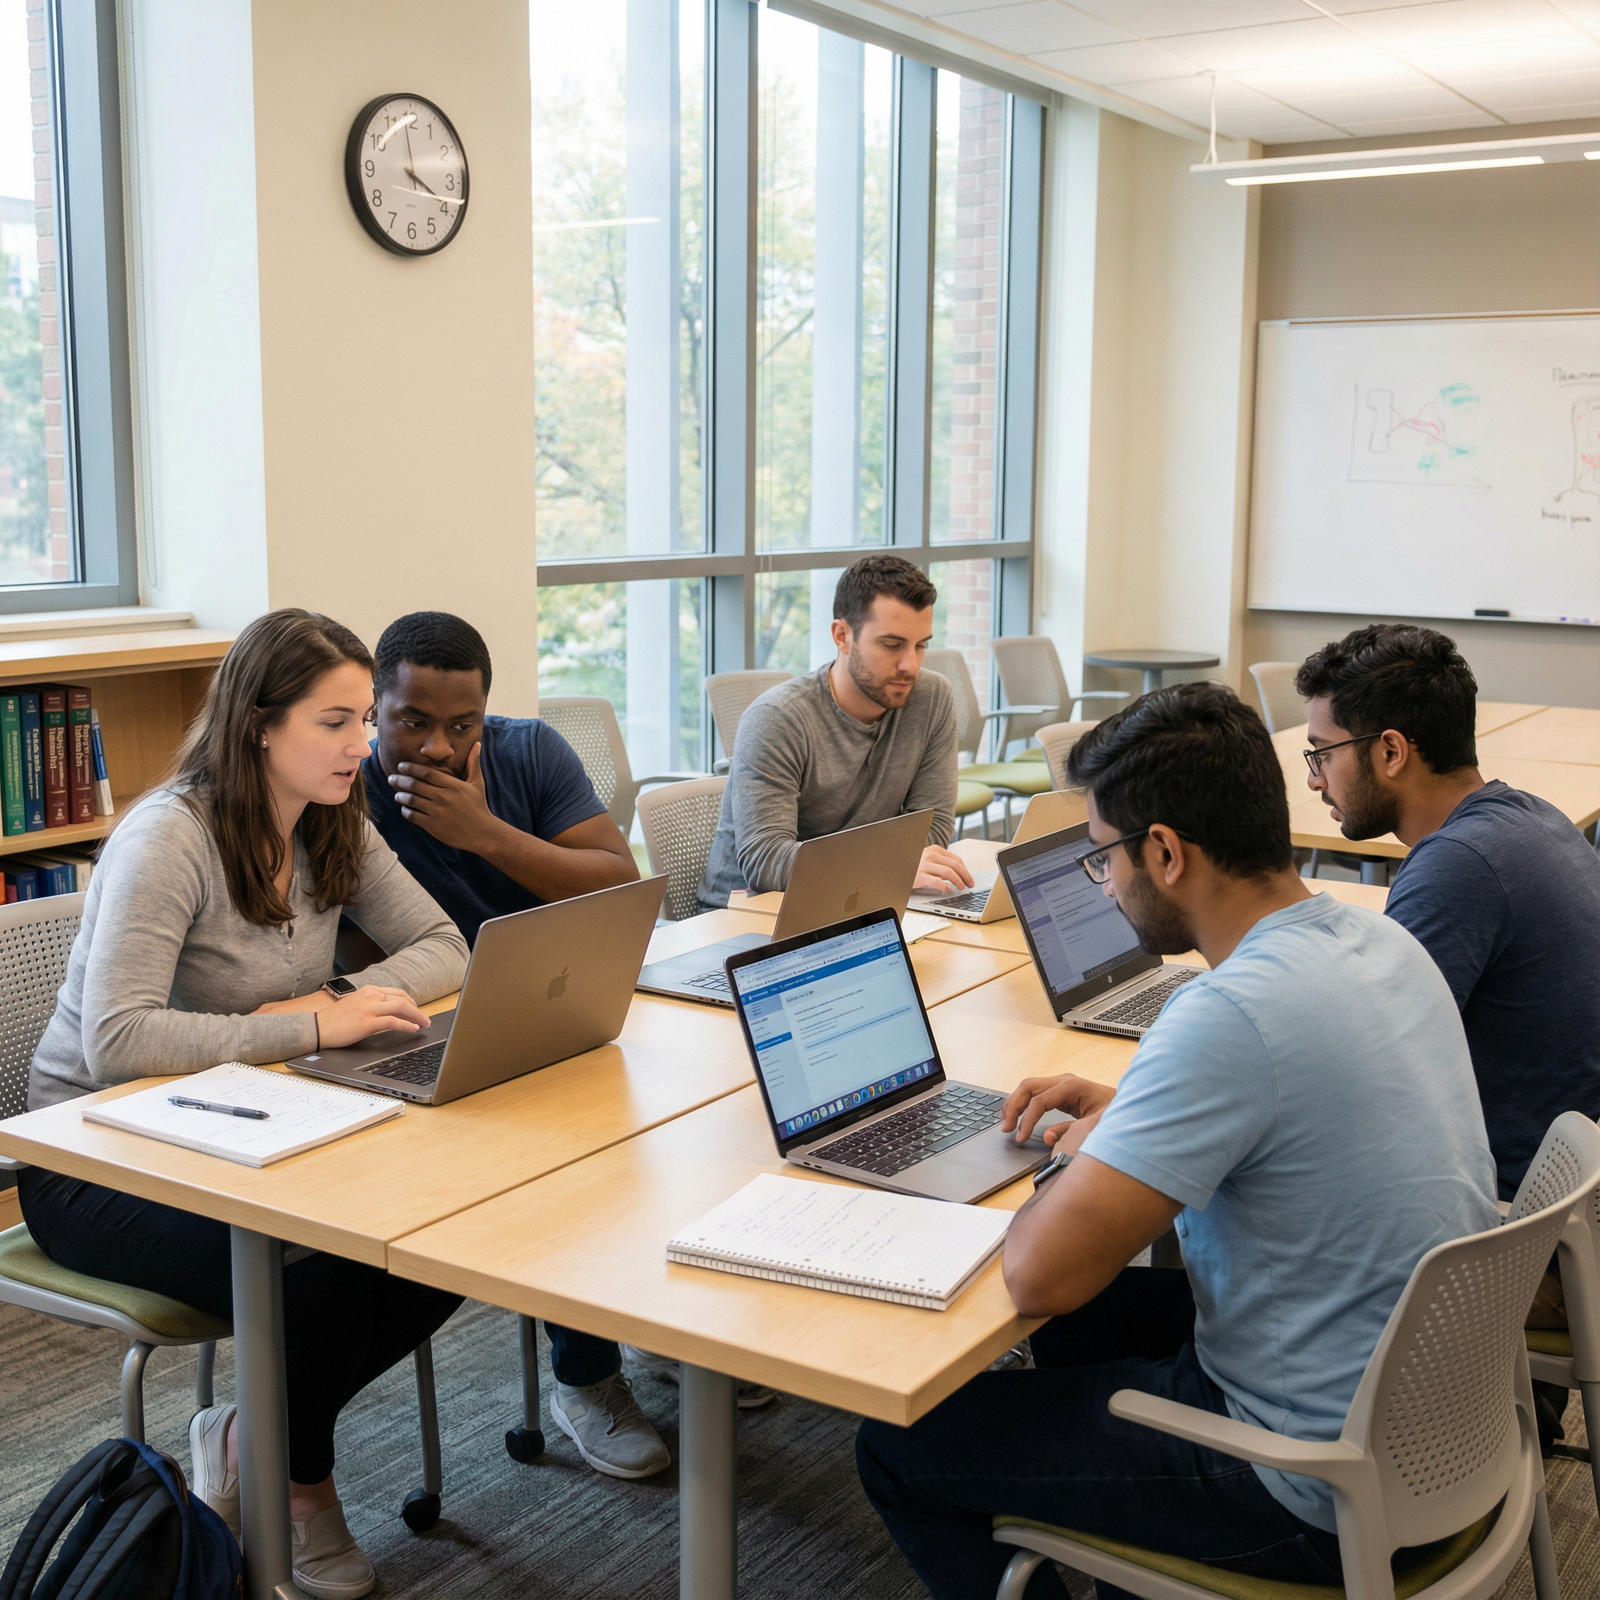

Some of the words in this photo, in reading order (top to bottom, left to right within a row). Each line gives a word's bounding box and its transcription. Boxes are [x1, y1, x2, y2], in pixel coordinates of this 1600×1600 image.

[384, 114, 398, 135] 11
[402, 110, 419, 130] 12
[426, 122, 433, 140] 1
[370, 133, 387, 152] 10
[439, 144, 449, 162] 2
[364, 159, 375, 178] 9
[445, 173, 455, 191] 3
[372, 189, 383, 208] 8
[439, 200, 449, 216] 4
[387, 211, 398, 229] 7
[426, 217, 436, 235] 5
[406, 221, 417, 240] 6
